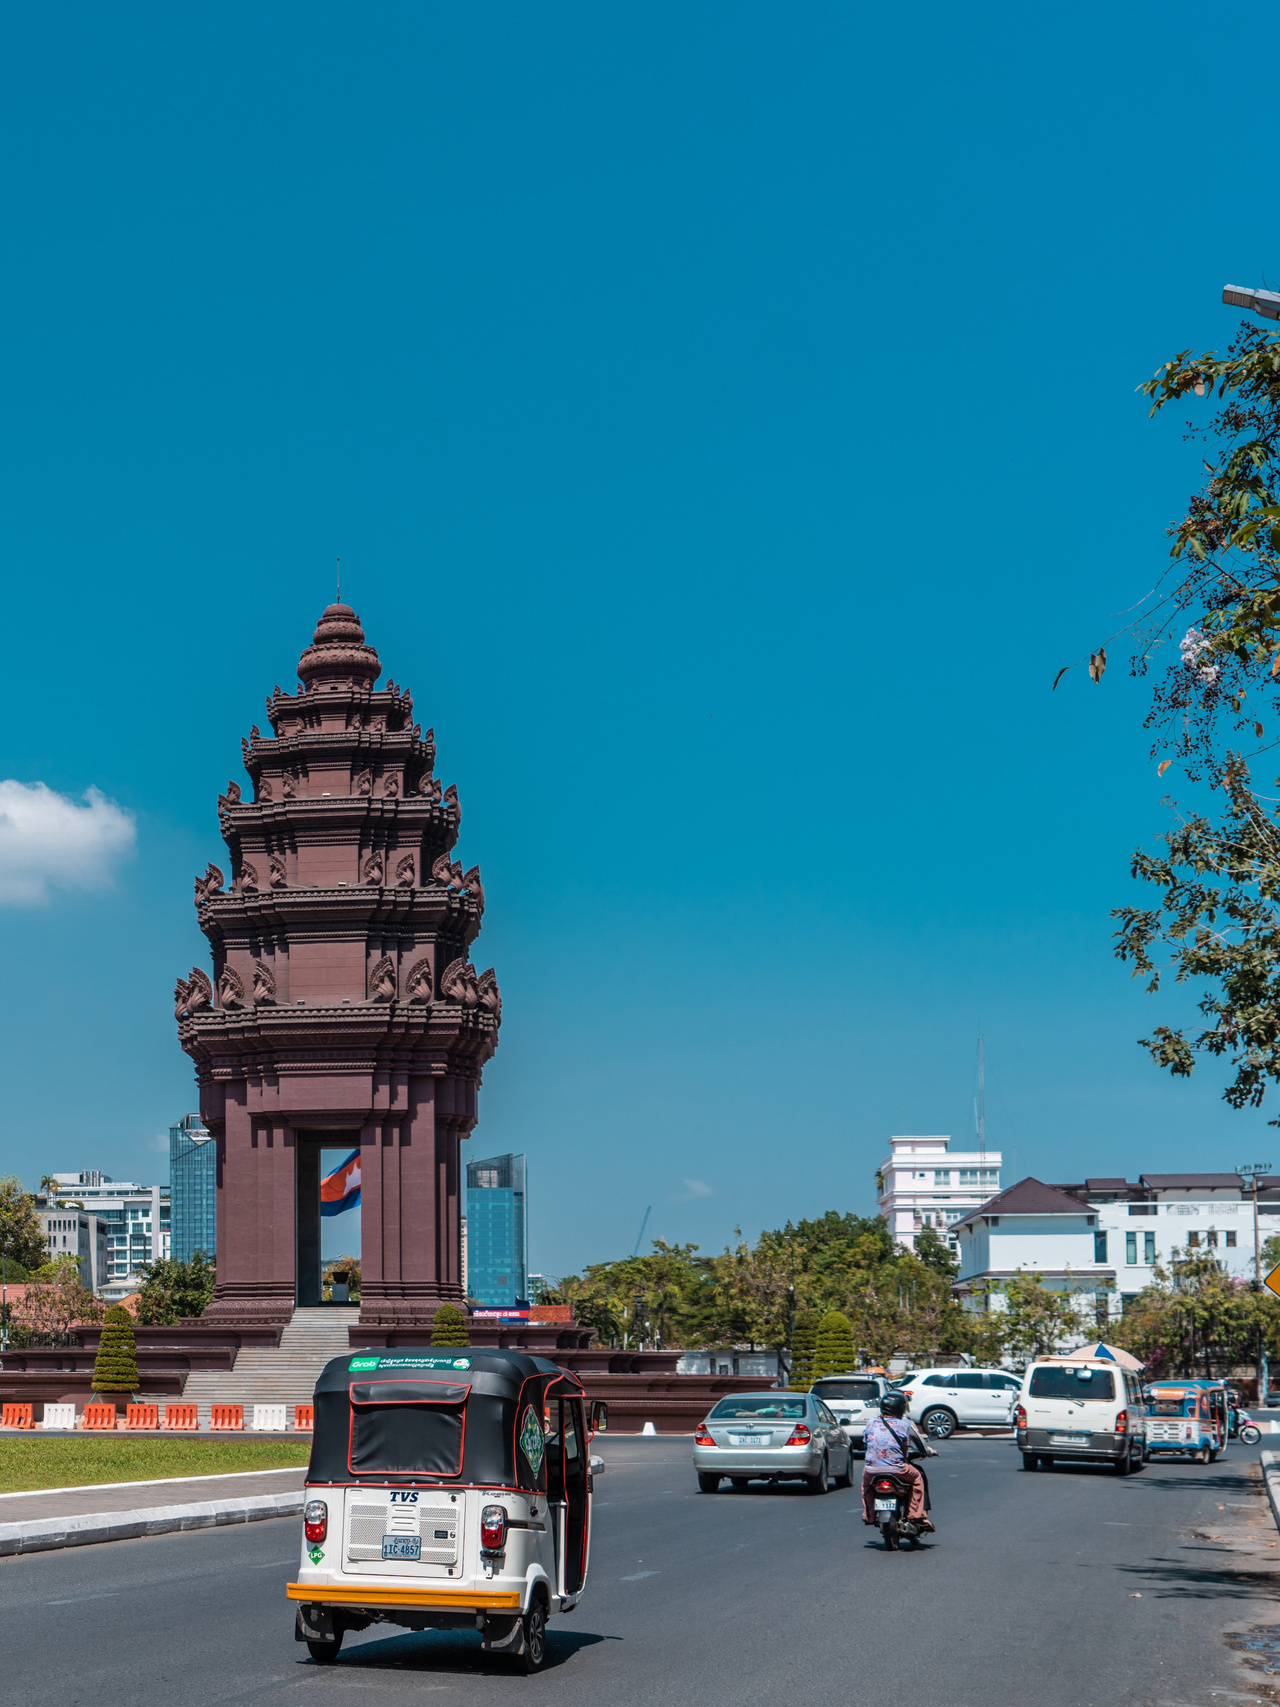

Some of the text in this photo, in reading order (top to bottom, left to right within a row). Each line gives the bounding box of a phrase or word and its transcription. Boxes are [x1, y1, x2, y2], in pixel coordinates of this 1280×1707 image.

[352, 1360, 376, 1368] Grab
[390, 1491, 419, 1502] TVS
[384, 1544, 419, 1555] 1IC-4857
